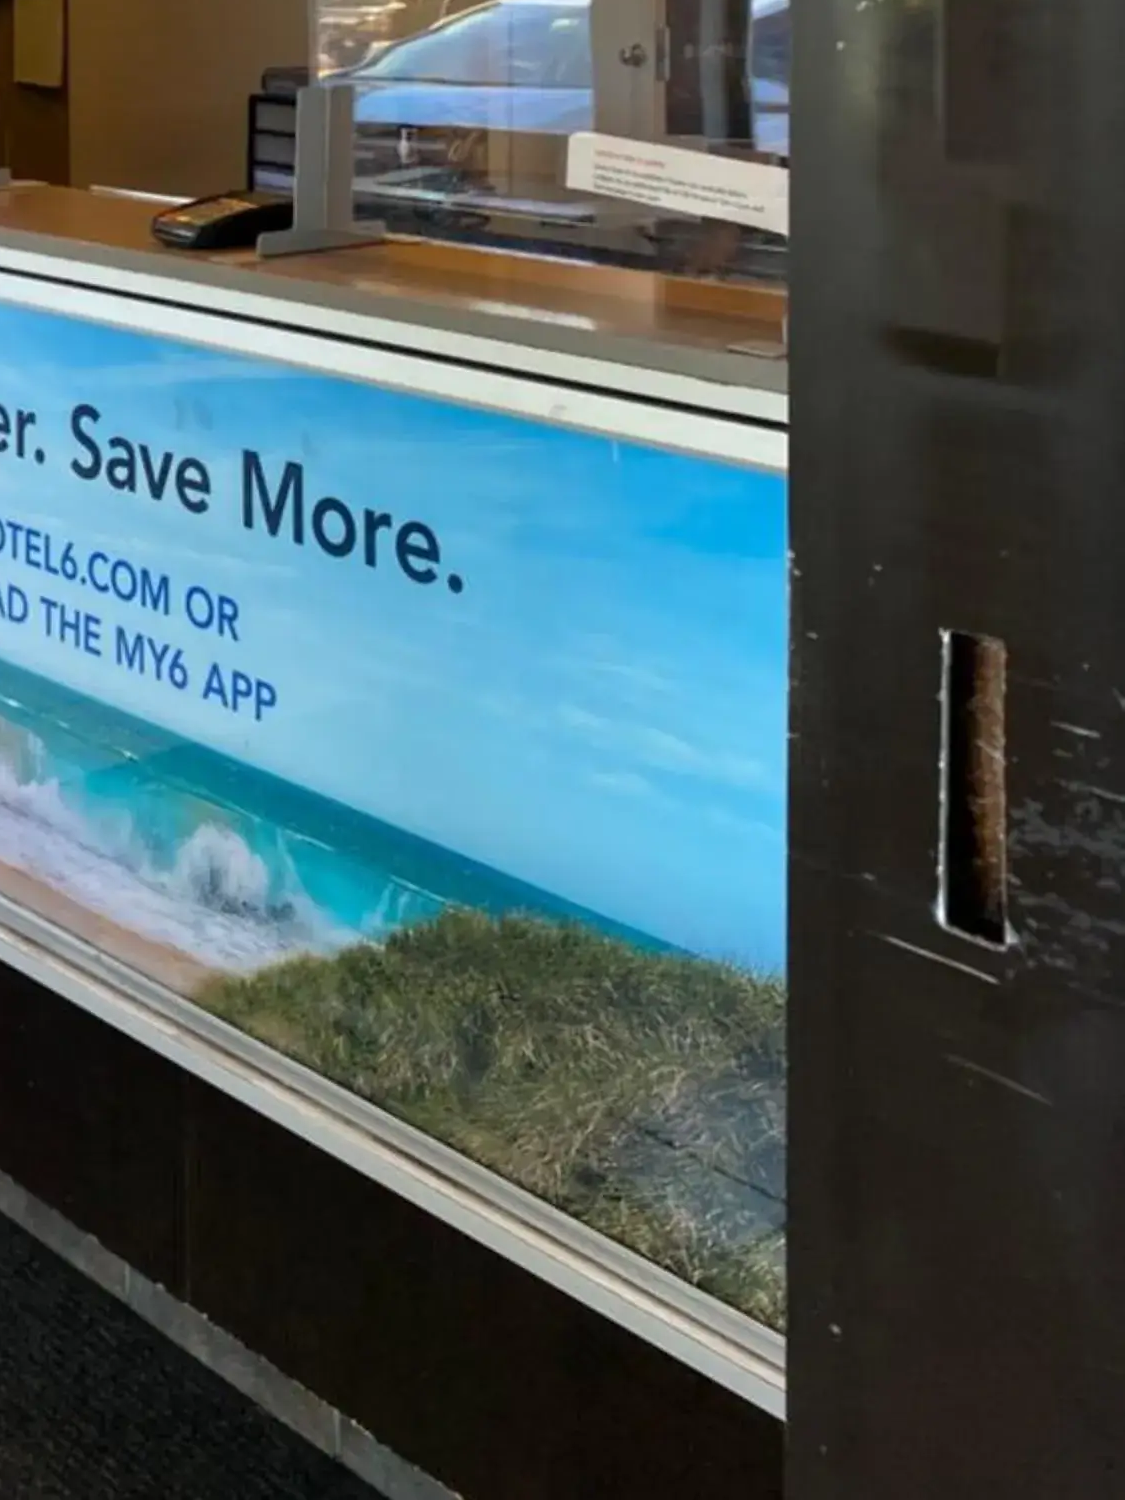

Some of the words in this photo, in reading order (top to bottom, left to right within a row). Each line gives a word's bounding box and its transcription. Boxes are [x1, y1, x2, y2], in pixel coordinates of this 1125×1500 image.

[70, 403, 212, 515] Save
[242, 449, 464, 594] More.
[39, 595, 102, 658] THE
[115, 625, 189, 690] MY6
[202, 661, 278, 722] APP
[184, 585, 240, 642] OR
